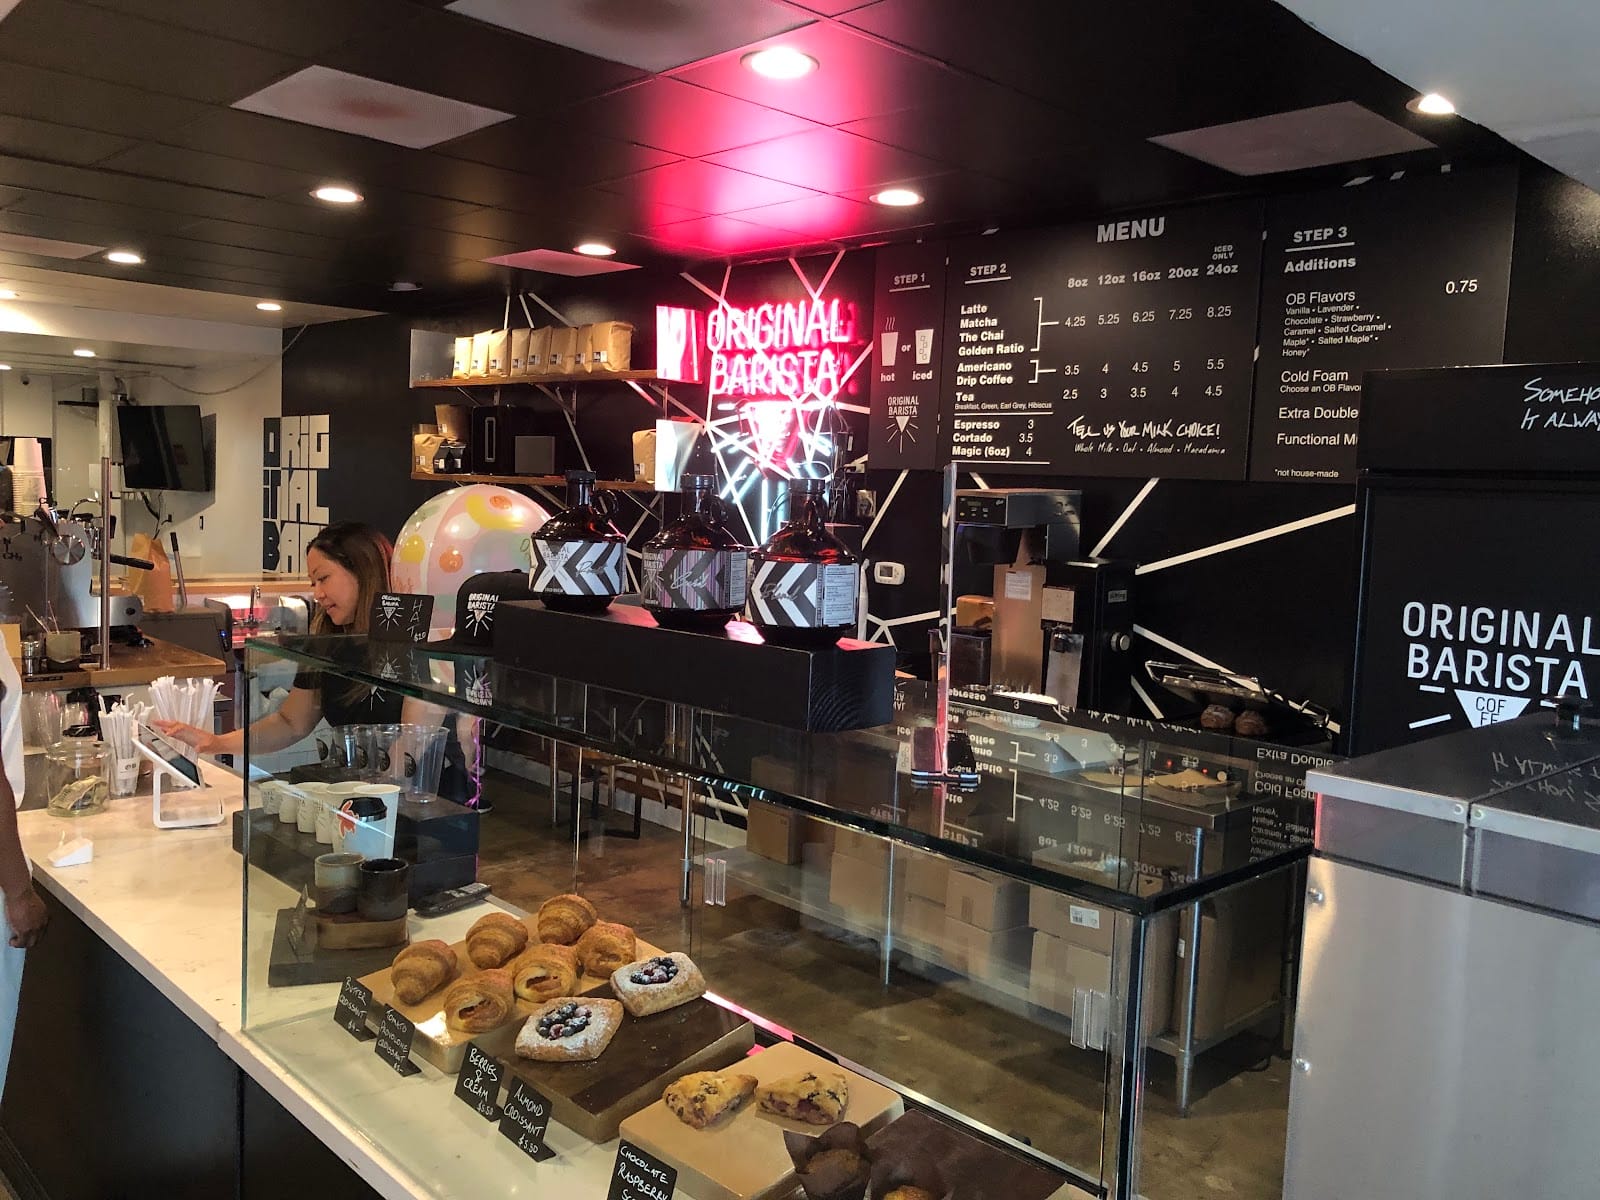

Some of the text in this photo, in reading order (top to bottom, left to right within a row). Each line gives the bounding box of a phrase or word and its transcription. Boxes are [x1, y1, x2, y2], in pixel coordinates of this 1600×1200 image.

[1097, 216, 1165, 243] MENU
[1294, 227, 1347, 243] STEP 3
[1212, 252, 1234, 260] ONLY
[970, 264, 1007, 276] STEP 2
[1285, 257, 1356, 273] Additions
[894, 273, 925, 285] STEP 1
[1068, 264, 1238, 288] 8oz 12oz 16oz 20oz 24oz
[1286, 279, 1478, 305] OB Flavors 0.75
[961, 304, 988, 314] Latte
[1286, 305, 1354, 315] Vanilla Lavender
[960, 306, 1232, 328] Matcha 4.25 5.25 6.25 7.25 8.25
[1285, 315, 1374, 325] Chocolate Strawberry
[707, 299, 849, 352] ORIGINAL
[1284, 323, 1386, 336] Caramel Salted Caramel
[959, 330, 1004, 342] The Chai
[1318, 337, 1343, 345] Salted
[902, 344, 911, 352] or
[959, 344, 1024, 356] Golden Ratio
[711, 349, 840, 395] BARISTA
[957, 359, 1224, 375] Americano 3.5 4 4.5 5 5.5
[881, 373, 895, 382] hot
[913, 371, 932, 380] iced
[956, 375, 1013, 387] Drip Coffee
[1281, 370, 1348, 382] Cold Foam
[956, 386, 1222, 402] Tea 2.5 3 3.5 4 4.5
[1323, 384, 1335, 392] OB
[888, 396, 919, 406] ORIGINAL
[888, 406, 917, 415] BARISTA
[1279, 407, 1358, 418] Extra Double
[954, 420, 1034, 430] Espresso 3
[1142, 419, 1172, 439] MILK
[1176, 422, 1220, 439] CHOICE!
[953, 434, 1033, 442] Cortado 3.5
[1277, 433, 1339, 445] Functional
[952, 446, 1032, 457] Magic (6oz) 4
[1291, 469, 1338, 477] house-made
[1402, 602, 1600, 655] ORIGINAL
[1408, 643, 1588, 699] BARISTA
[1476, 697, 1507, 713] COF
[345, 977, 366, 1005] BUTTER
[470, 1048, 497, 1081] BERRIES
[475, 1070, 482, 1083] &
[464, 1078, 488, 1102] CREAM
[514, 1084, 543, 1116] ALMOND
[504, 1103, 544, 1136] CROISSANT
[518, 1134, 538, 1153] $5.50
[621, 1146, 668, 1184] CHOCOLATE
[618, 1162, 668, 1200] RASPBERRY
